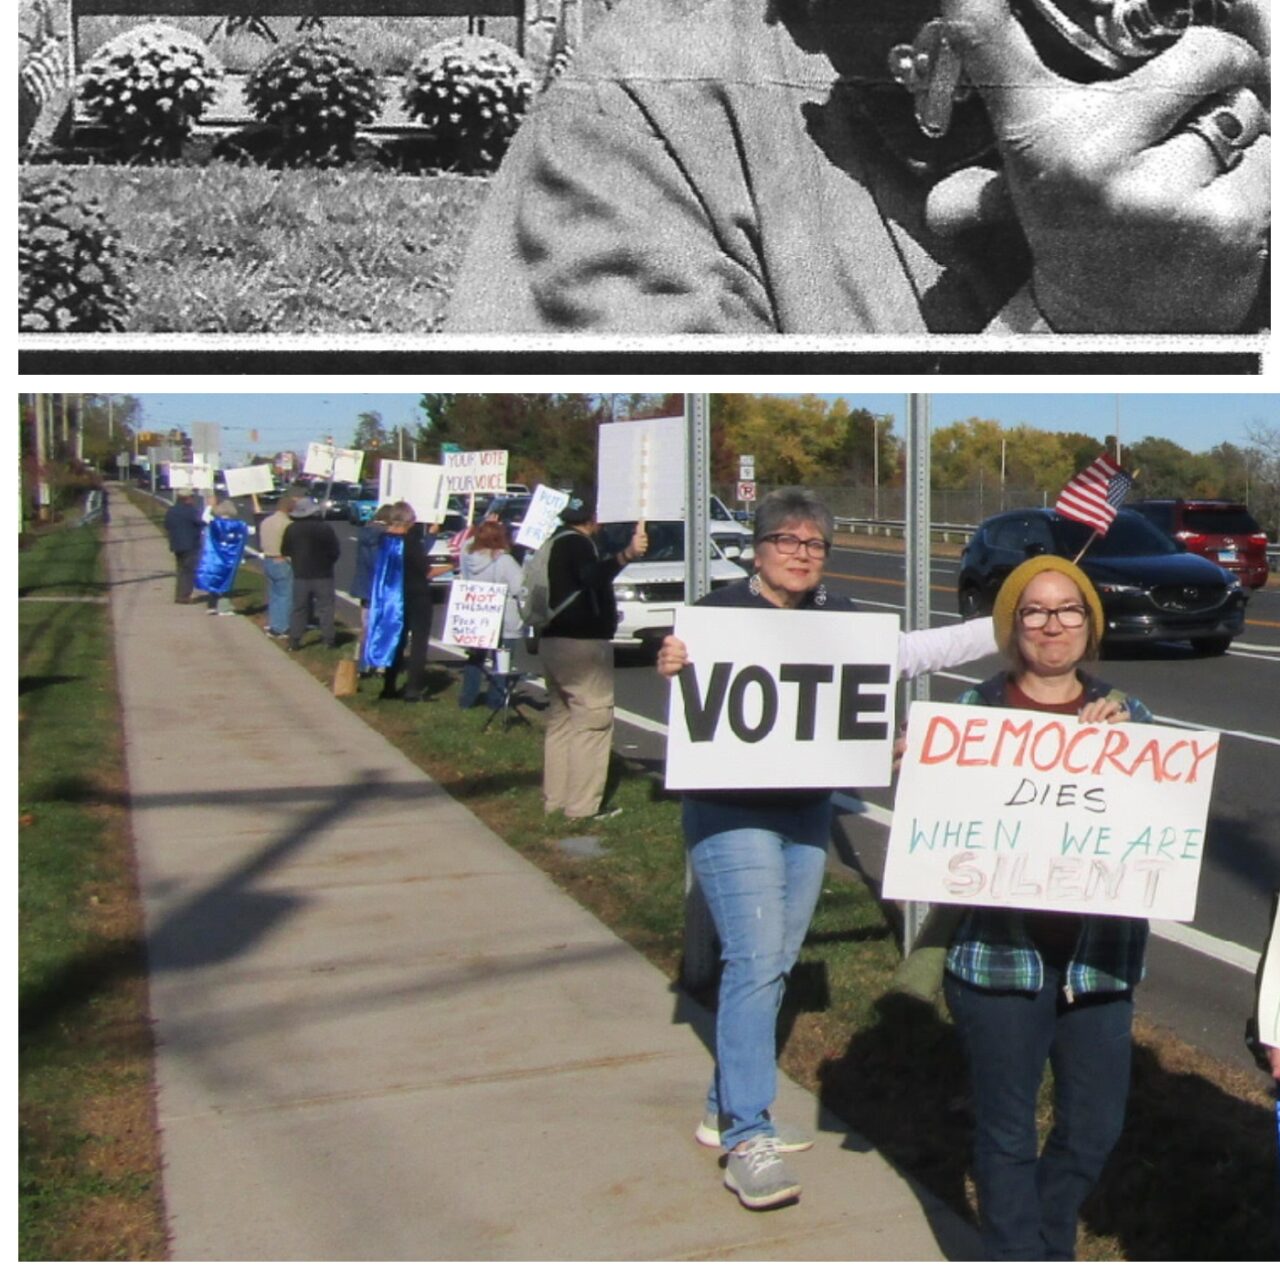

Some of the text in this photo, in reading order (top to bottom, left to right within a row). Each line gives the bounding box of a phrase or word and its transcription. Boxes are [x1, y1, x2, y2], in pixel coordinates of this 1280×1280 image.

[480, 451, 505, 466] VOTE
[446, 474, 504, 491] YOUR VOICE
[465, 592, 496, 602] NOT
[675, 662, 892, 743] VOTE
[919, 715, 1218, 785] DEMOCRACY
[1005, 777, 1107, 813] DIES
[908, 817, 1203, 861] WHEN WE ARE
[943, 850, 1168, 910] SILENT
